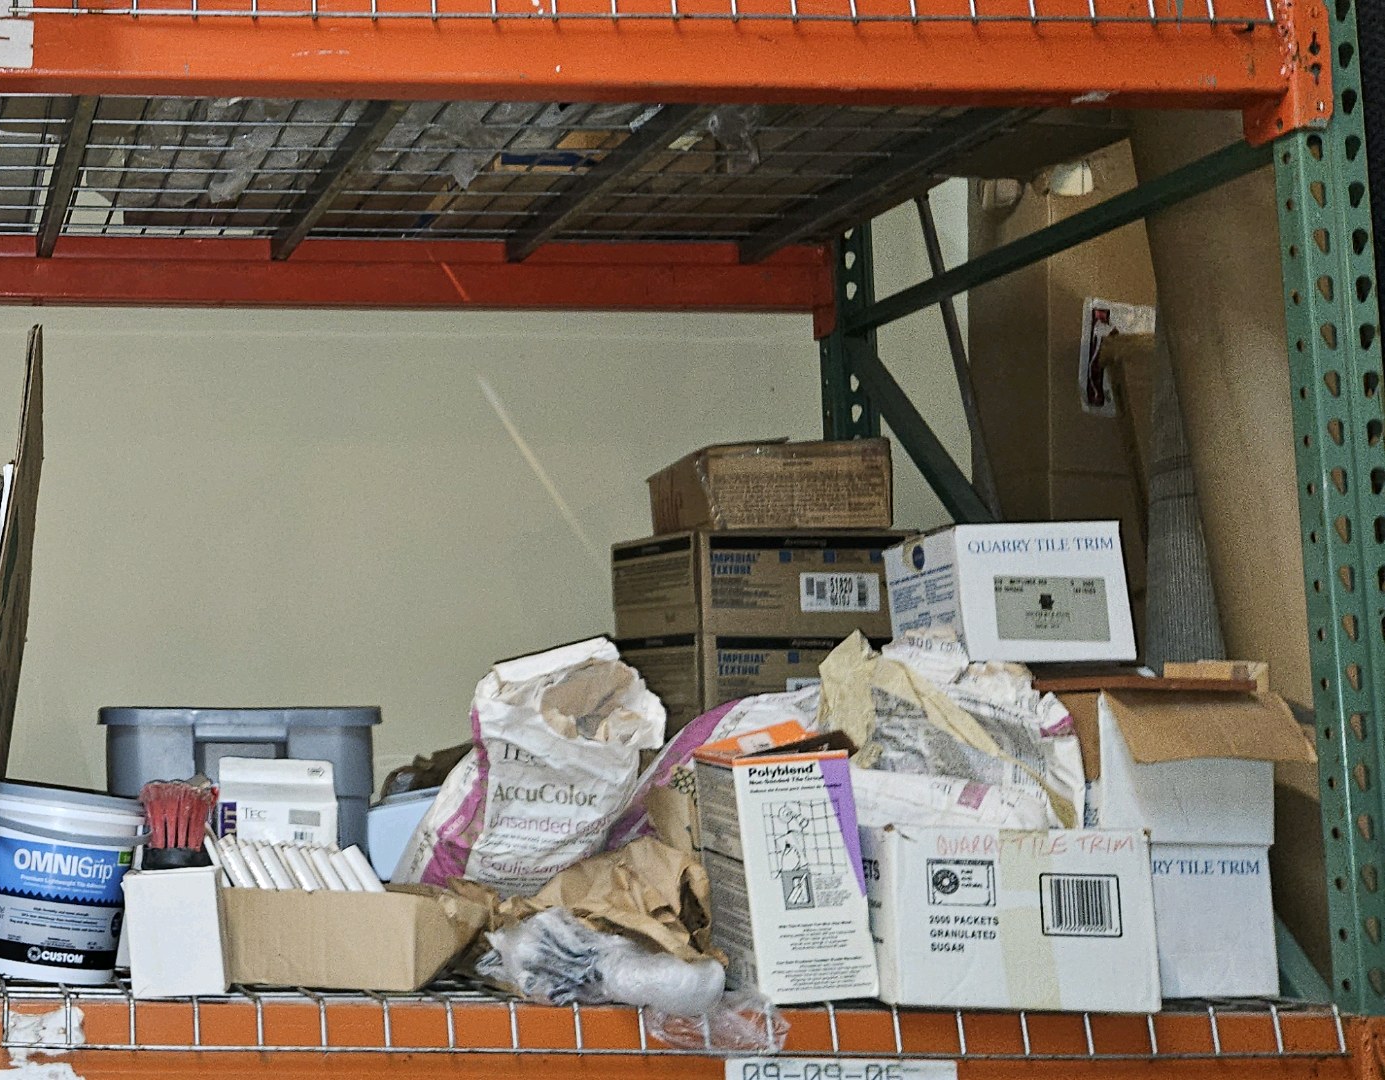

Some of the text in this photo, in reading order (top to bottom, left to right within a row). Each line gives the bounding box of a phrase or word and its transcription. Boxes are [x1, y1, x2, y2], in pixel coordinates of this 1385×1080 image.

[967, 536, 1114, 554] QUARRY TILE TRIM
[748, 763, 815, 779] Polyblend
[492, 782, 597, 808] AccuColor
[241, 807, 268, 820] TEC
[490, 813, 572, 835] Unsanded
[1010, 835, 1067, 857] TILE
[1077, 836, 1135, 854] TRIM
[13, 848, 114, 884] OMNIGrip
[1176, 859, 1214, 875] TILE
[1218, 859, 1261, 875] TRIM
[929, 915, 1000, 927] 2000 PACKETS
[930, 929, 997, 940] GRANULATED
[931, 942, 964, 952] SUGAR
[41, 950, 84, 964] CUSTOM
